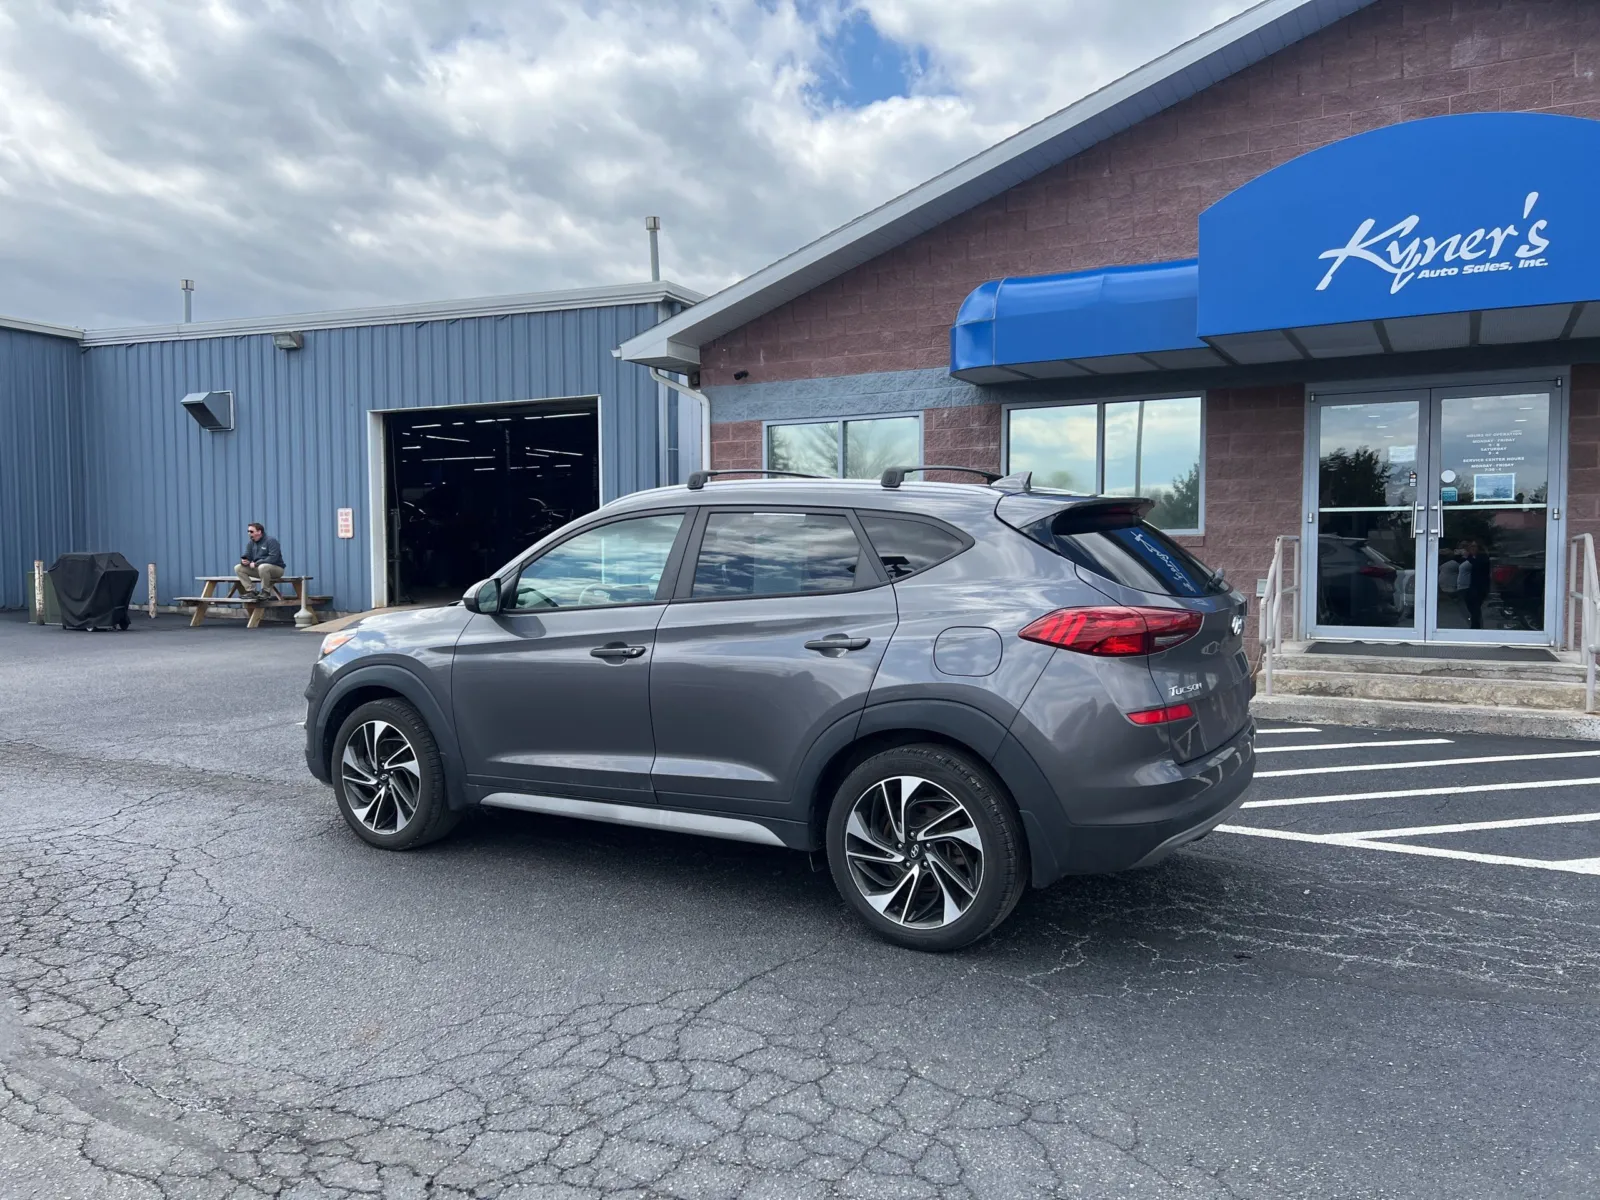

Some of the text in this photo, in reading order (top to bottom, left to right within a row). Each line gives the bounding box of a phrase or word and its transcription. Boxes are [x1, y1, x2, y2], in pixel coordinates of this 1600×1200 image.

[1315, 191, 1550, 295] Kyner's
[1417, 257, 1549, 279] Auto Sales, Inc.
